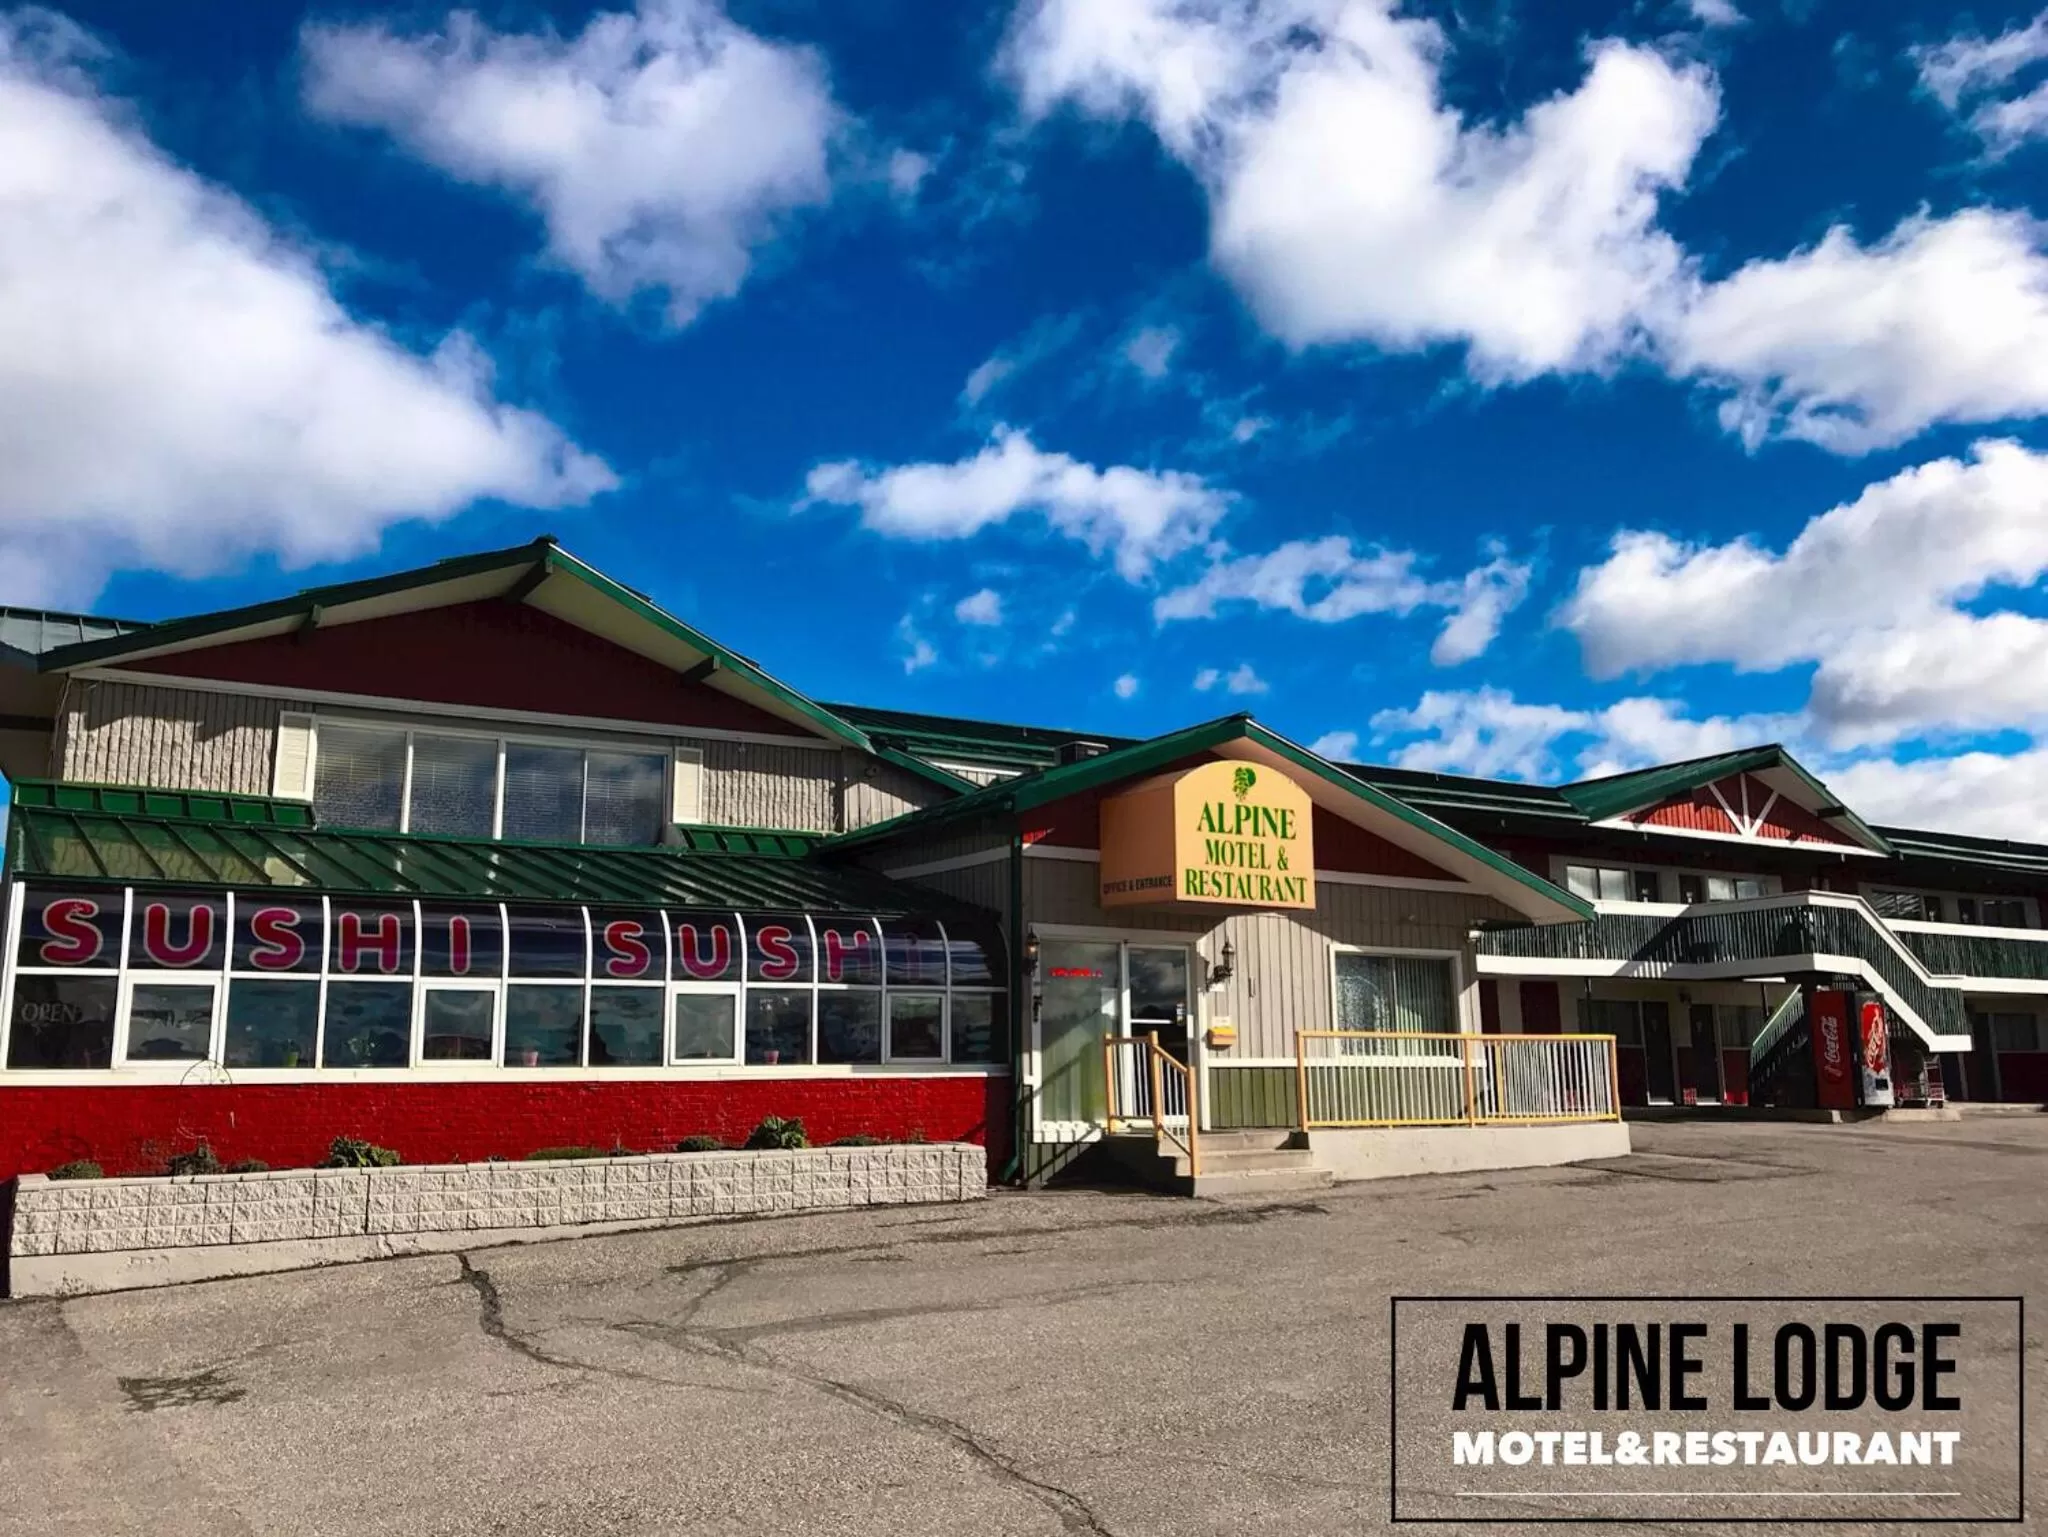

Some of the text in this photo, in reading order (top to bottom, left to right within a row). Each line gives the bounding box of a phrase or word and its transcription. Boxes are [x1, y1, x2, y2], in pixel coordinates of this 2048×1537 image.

[1197, 801, 1296, 840] ALPINE
[1205, 839, 1289, 871] MOTEL &
[1136, 875, 1172, 891] ENTRANCE
[1185, 869, 1307, 903] RESTAURANT
[40, 898, 472, 975] SUSHI
[21, 1003, 76, 1021] OPEN
